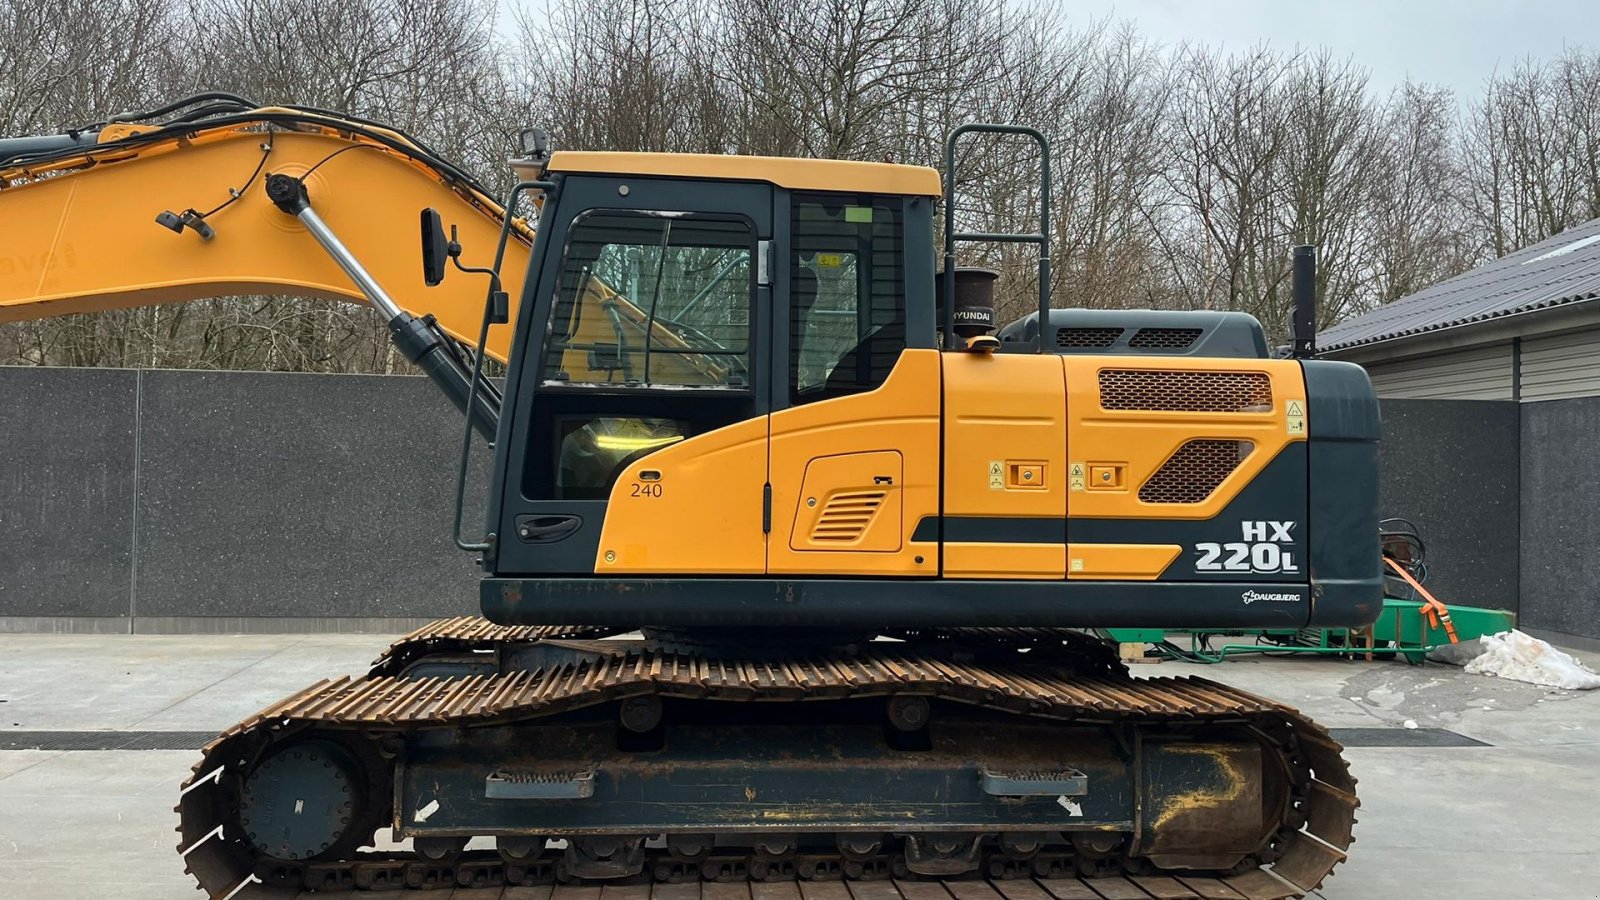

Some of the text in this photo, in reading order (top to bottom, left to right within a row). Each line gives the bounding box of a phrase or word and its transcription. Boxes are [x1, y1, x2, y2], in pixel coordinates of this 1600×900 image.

[630, 483, 662, 498] 240
[1241, 521, 1296, 542] HX
[1194, 542, 1299, 573] 220L
[1253, 593, 1301, 602] DAUGBJERG
